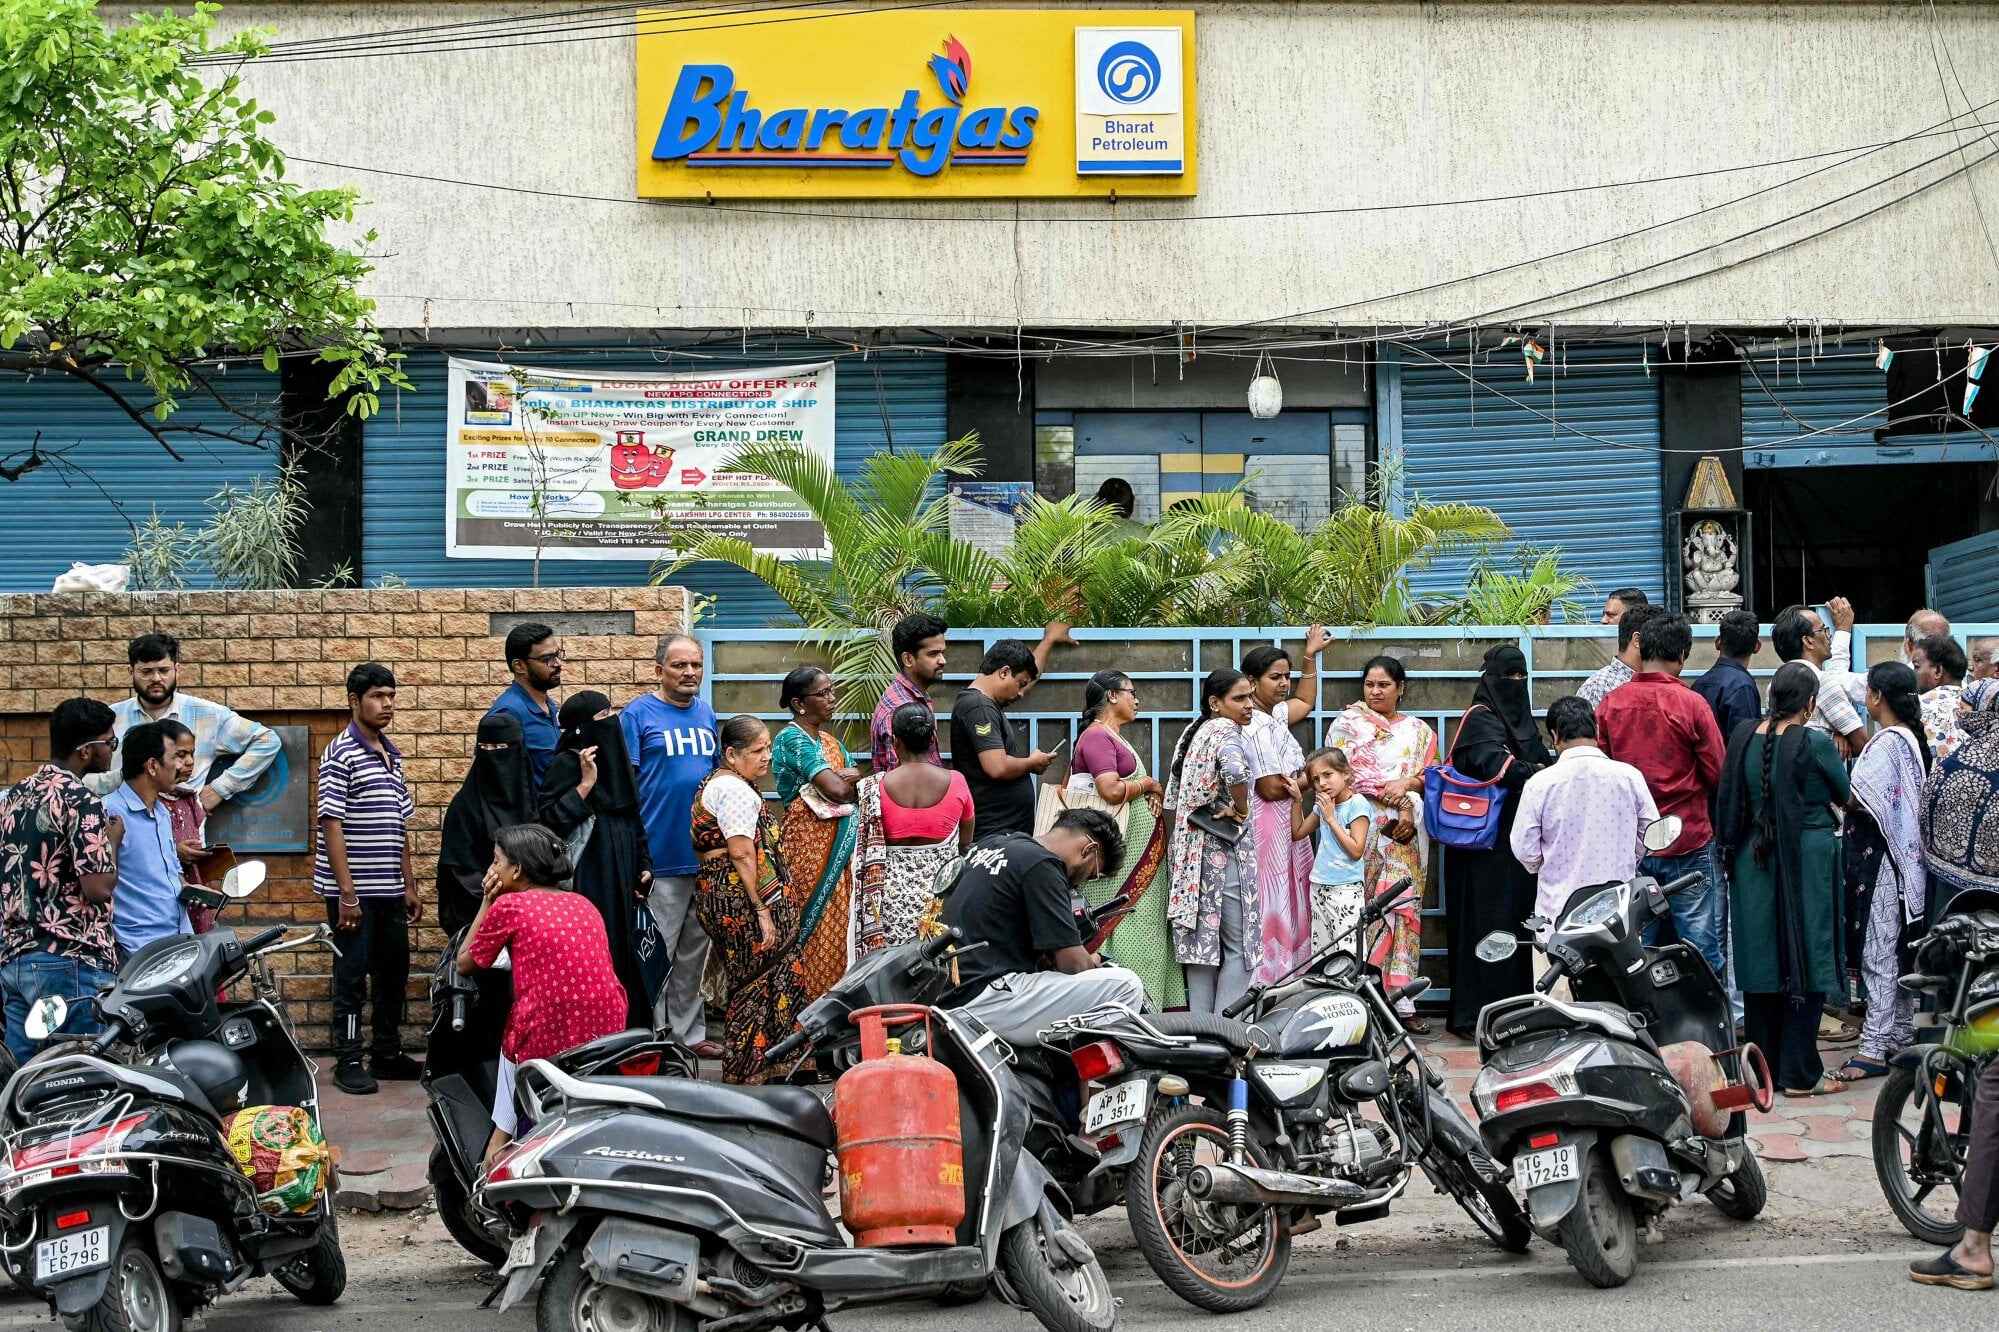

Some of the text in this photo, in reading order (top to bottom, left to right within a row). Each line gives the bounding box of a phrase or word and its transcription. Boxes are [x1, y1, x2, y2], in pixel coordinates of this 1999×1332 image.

[652, 64, 1040, 177] Bharatgas
[1105, 120, 1154, 134] Bharat
[1092, 137, 1168, 151] Petroleum
[600, 380, 660, 389] LUCKY
[669, 380, 723, 389] DRAW
[729, 380, 788, 389] OFFER
[571, 400, 666, 409] BHARATGAS
[671, 400, 777, 409] DISTRIBUTOR
[783, 399, 818, 408] SHIP
[646, 412, 664, 420] Big
[692, 412, 721, 420] Every
[582, 420, 610, 428] Lucky
[640, 420, 679, 428] Coupon
[696, 420, 723, 428] Every
[463, 434, 491, 443] Exciting
[554, 436, 597, 444] Connections
[693, 430, 804, 442] GRAND DREW
[481, 451, 507, 459] PRIZE
[466, 463, 509, 471] 2nd PRIZE
[482, 475, 510, 483] PRIZE
[509, 493, 530, 501] How
[547, 521, 580, 529] Publicly
[663, 727, 717, 757] IHD
[1322, 1001, 1354, 1012] HERO
[1323, 1008, 1361, 1020] HONDA
[45, 1076, 86, 1089] HONDA
[1099, 1088, 1127, 1111] AP 10
[1090, 1103, 1136, 1129] AD 3517
[1523, 1149, 1568, 1171] TG 10
[49, 1239, 69, 1257] TG
[81, 1231, 100, 1249] 10
[49, 1247, 100, 1274] E6796
